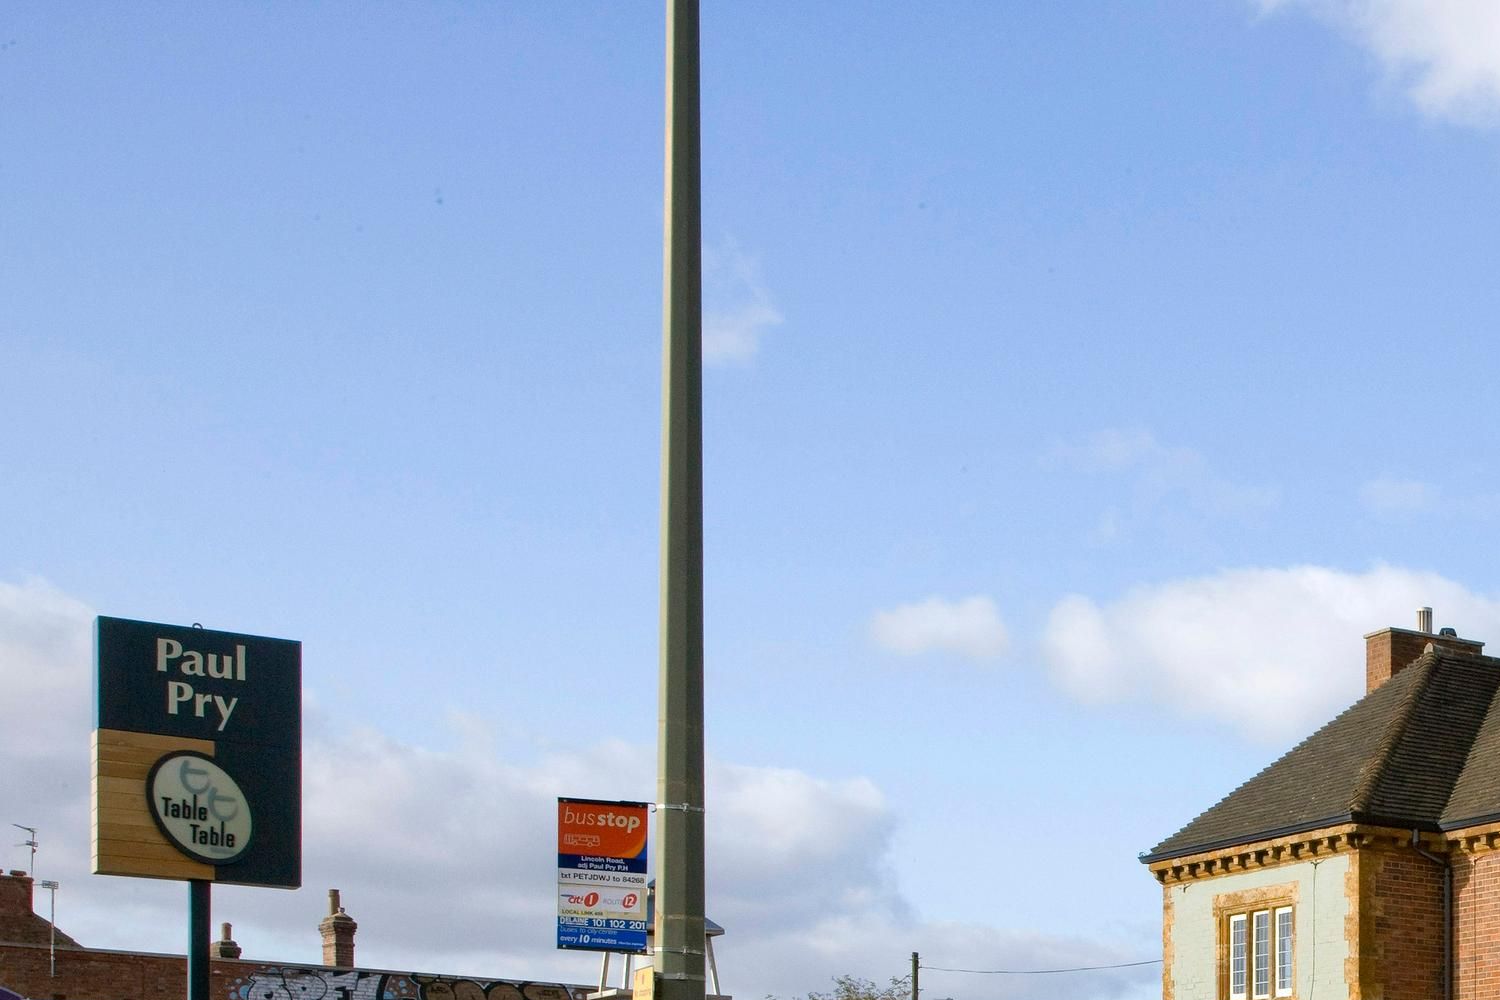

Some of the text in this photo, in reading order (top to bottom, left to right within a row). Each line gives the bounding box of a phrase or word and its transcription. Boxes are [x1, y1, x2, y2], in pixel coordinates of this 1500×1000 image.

[157, 638, 246, 681] Paul
[167, 681, 238, 731] Pry
[161, 795, 208, 821] Table
[564, 806, 640, 833] bus stop
[190, 822, 235, 848] Table
[625, 896, 634, 906] 12
[560, 917, 645, 930] DELAINE 101 102 201
[560, 935, 578, 943] every
[579, 934, 590, 943] 10
